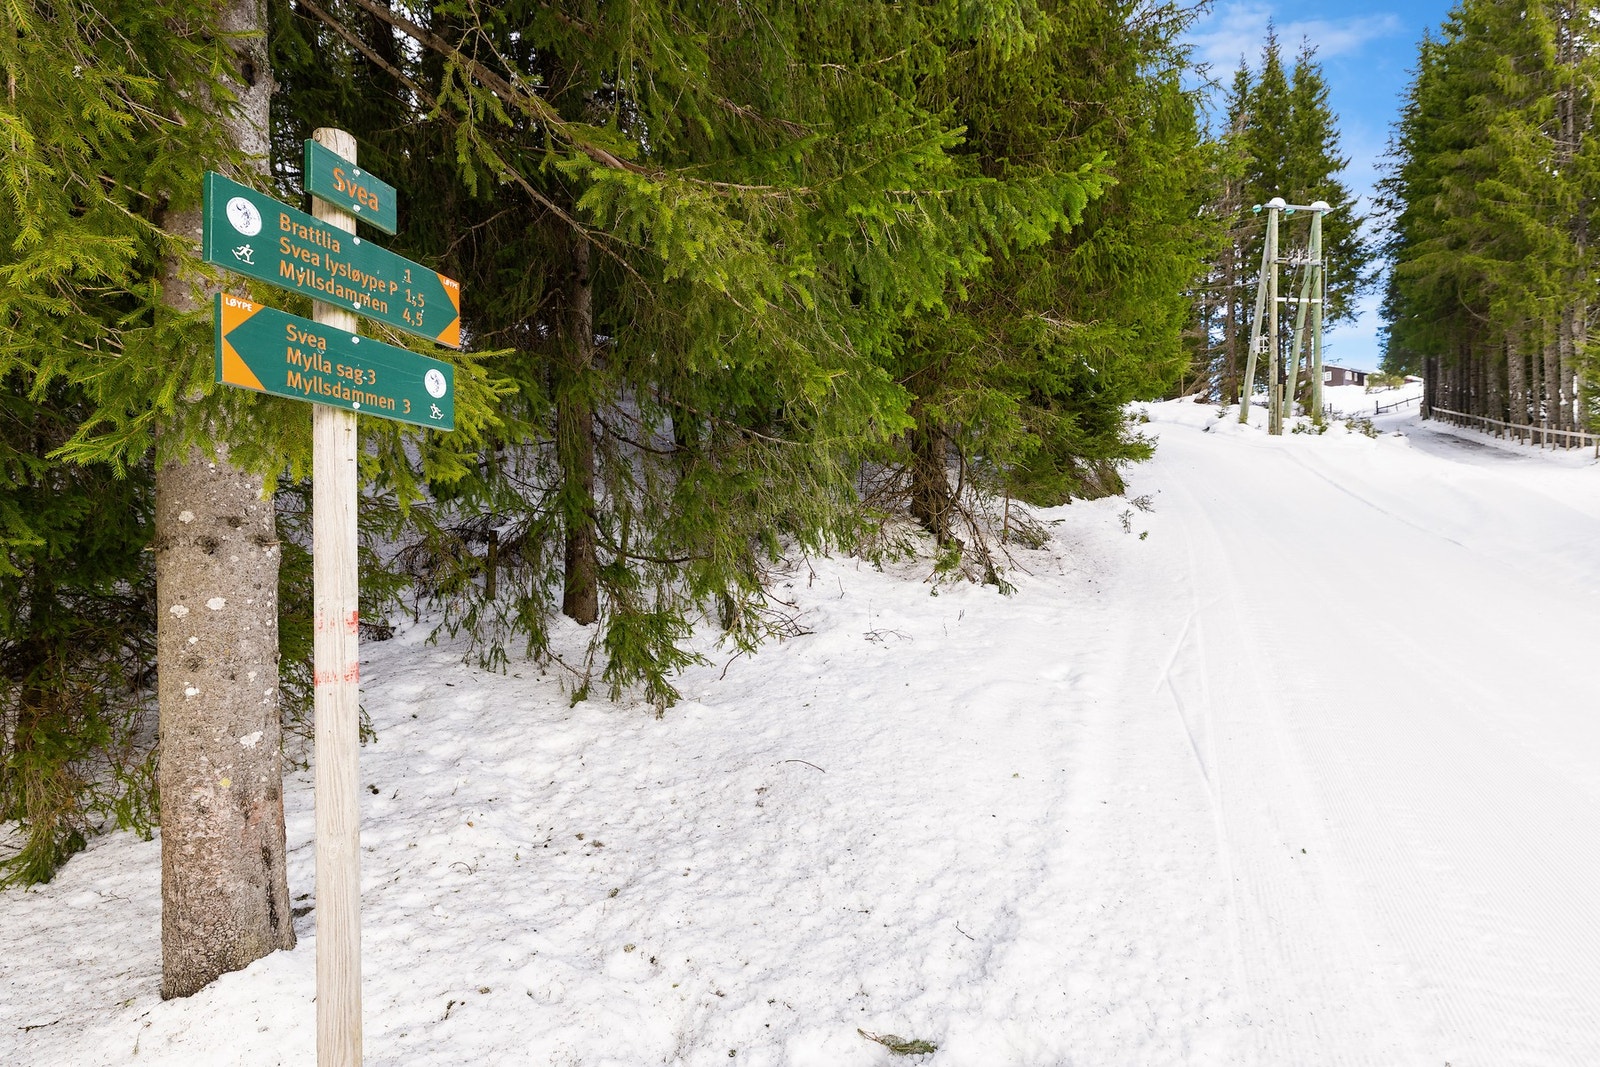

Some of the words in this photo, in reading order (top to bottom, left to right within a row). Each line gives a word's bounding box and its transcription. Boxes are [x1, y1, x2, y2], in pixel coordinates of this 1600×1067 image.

[333, 167, 380, 212] Svea
[280, 213, 341, 253] Brattlia
[404, 269, 412, 283] 1
[280, 236, 320, 266] Svea
[325, 254, 386, 293] lysløype
[389, 280, 398, 296] P
[405, 288, 425, 307] 1,5
[280, 260, 389, 314] Myllsdammen
[402, 308, 424, 326] 4,5
[225, 296, 253, 312] LØYPE
[286, 324, 327, 351] Svea
[286, 346, 332, 374] Mylla
[286, 370, 396, 411] Myllsdammen
[402, 399, 412, 414] 3
